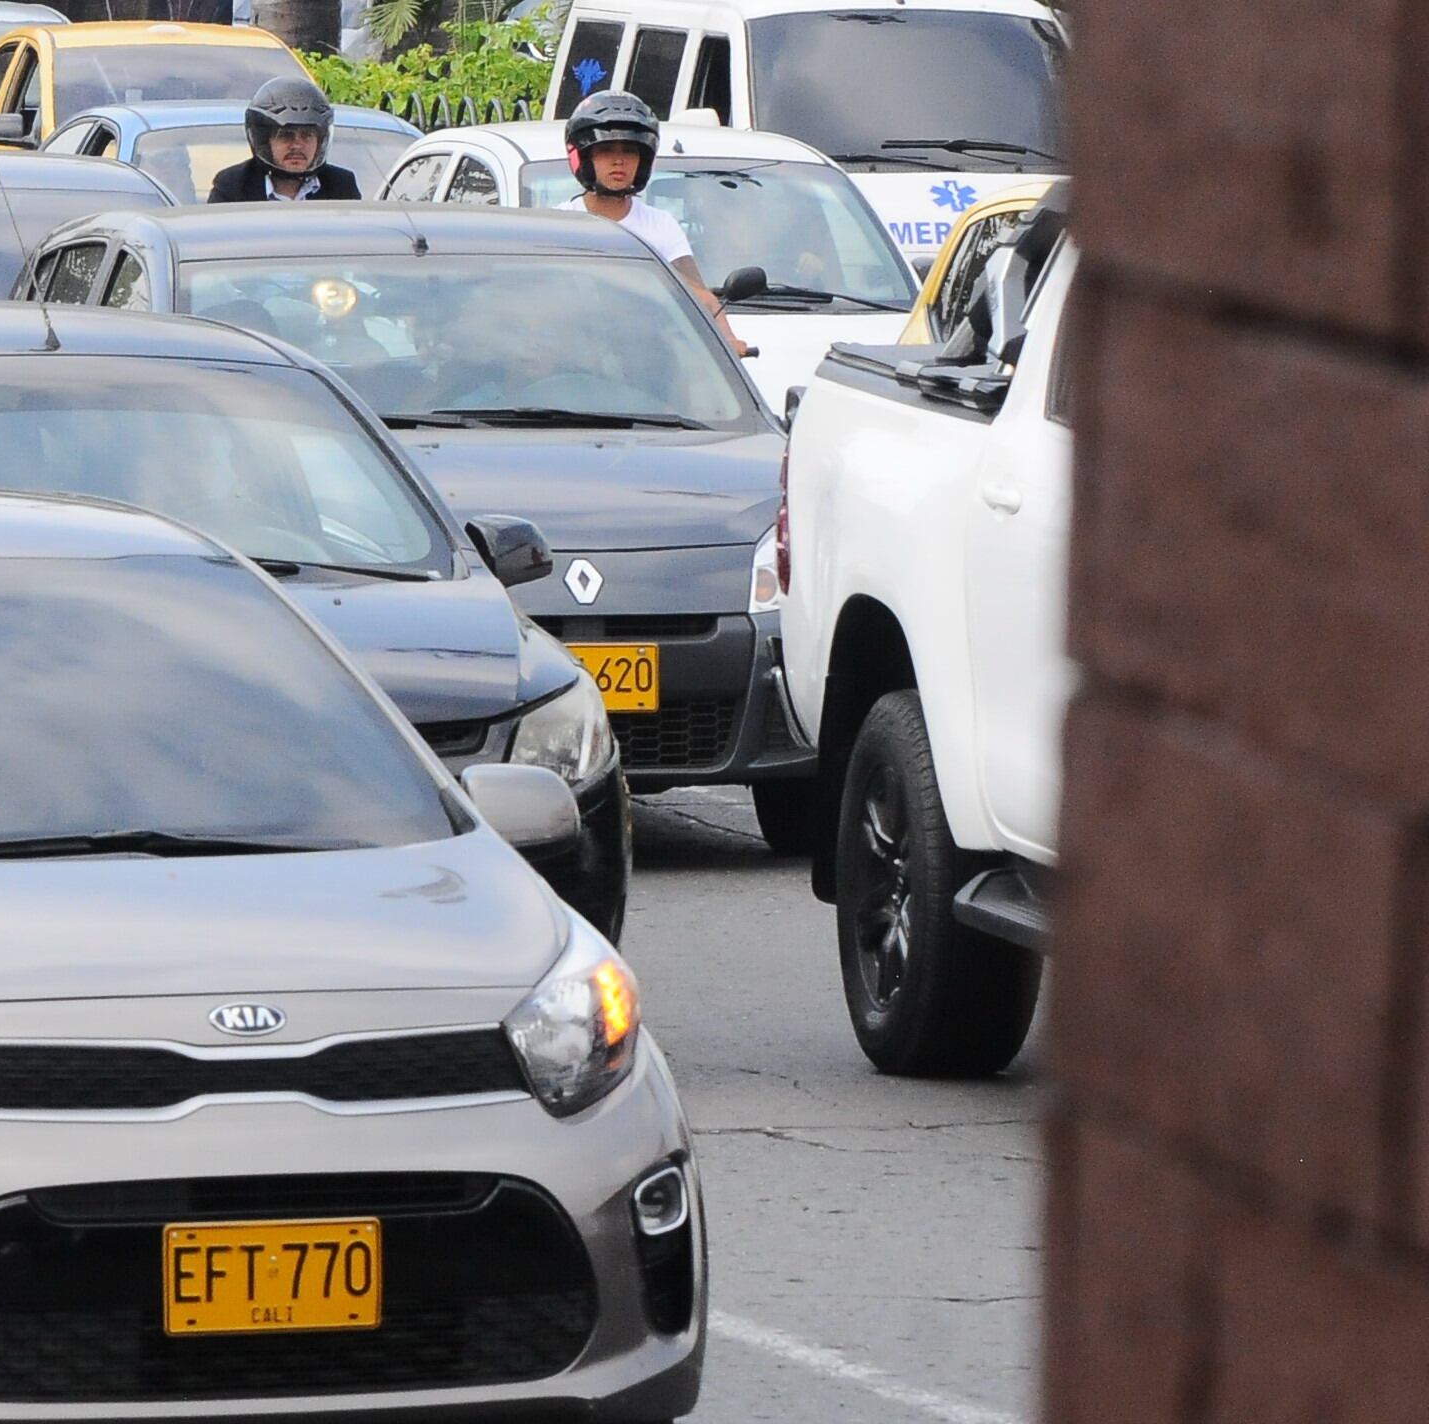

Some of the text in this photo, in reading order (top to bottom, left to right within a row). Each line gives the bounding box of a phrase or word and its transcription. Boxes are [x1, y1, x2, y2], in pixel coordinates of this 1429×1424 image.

[595, 657, 653, 693] 620
[222, 1006, 279, 1027] KIA
[174, 1240, 372, 1304] EFT 770
[250, 1307, 294, 1324] CALI
